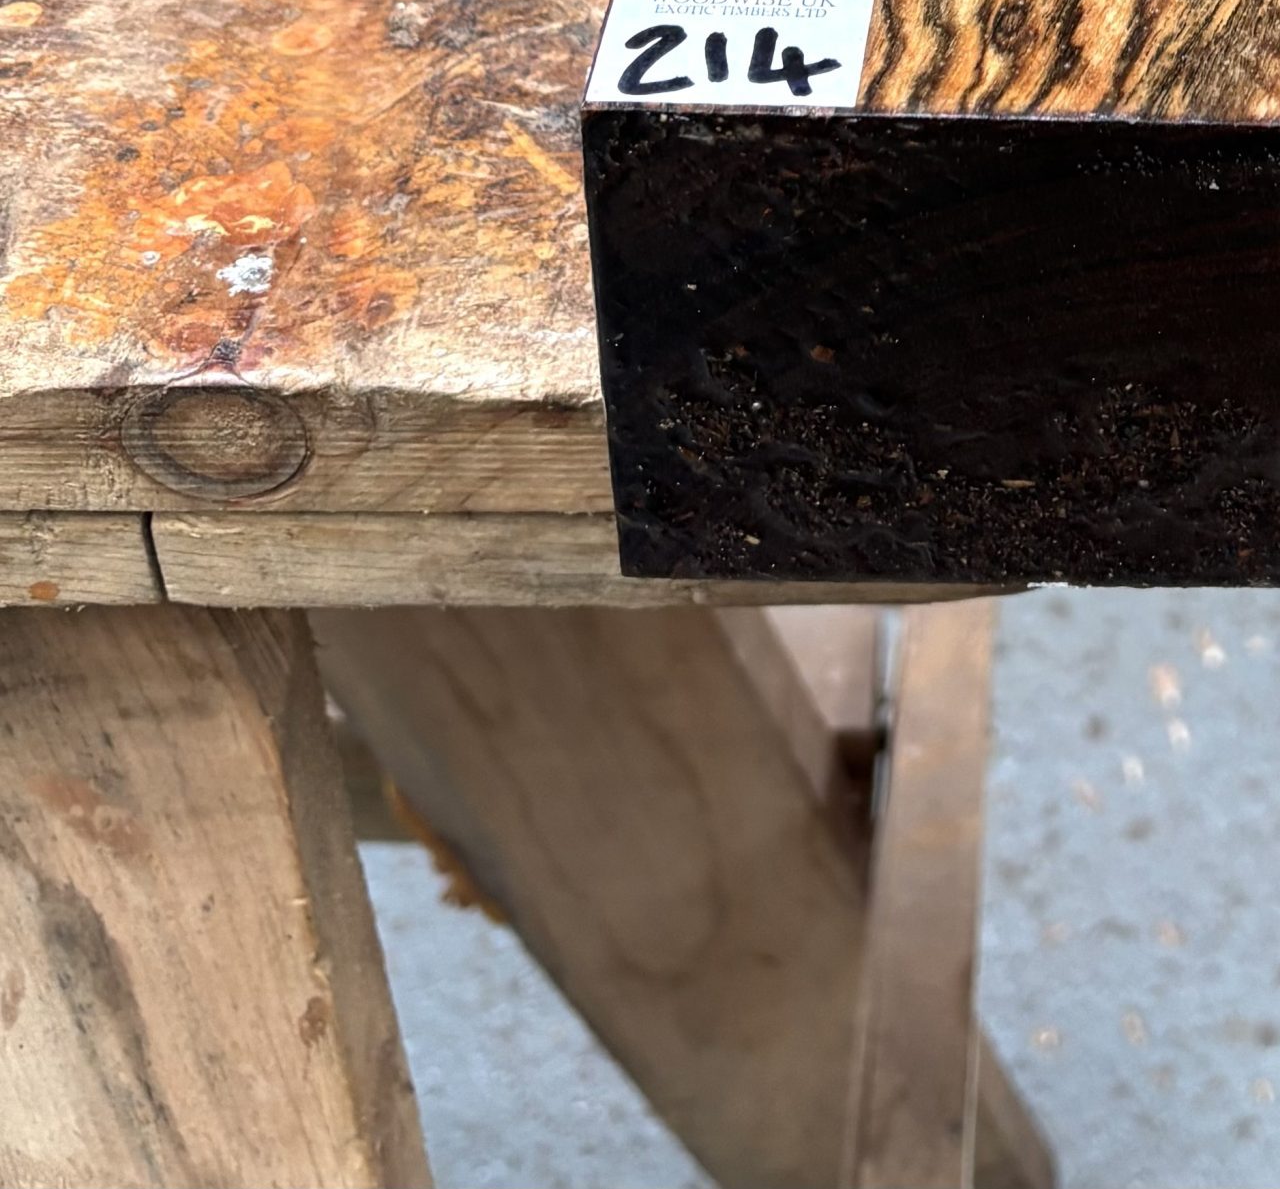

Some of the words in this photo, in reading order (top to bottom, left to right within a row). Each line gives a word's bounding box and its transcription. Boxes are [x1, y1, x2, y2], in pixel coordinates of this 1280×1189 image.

[655, 3, 717, 16] EXOTIC
[720, 5, 791, 18] TIMBERS
[795, 7, 828, 19] LTD
[617, 24, 842, 97] 214
